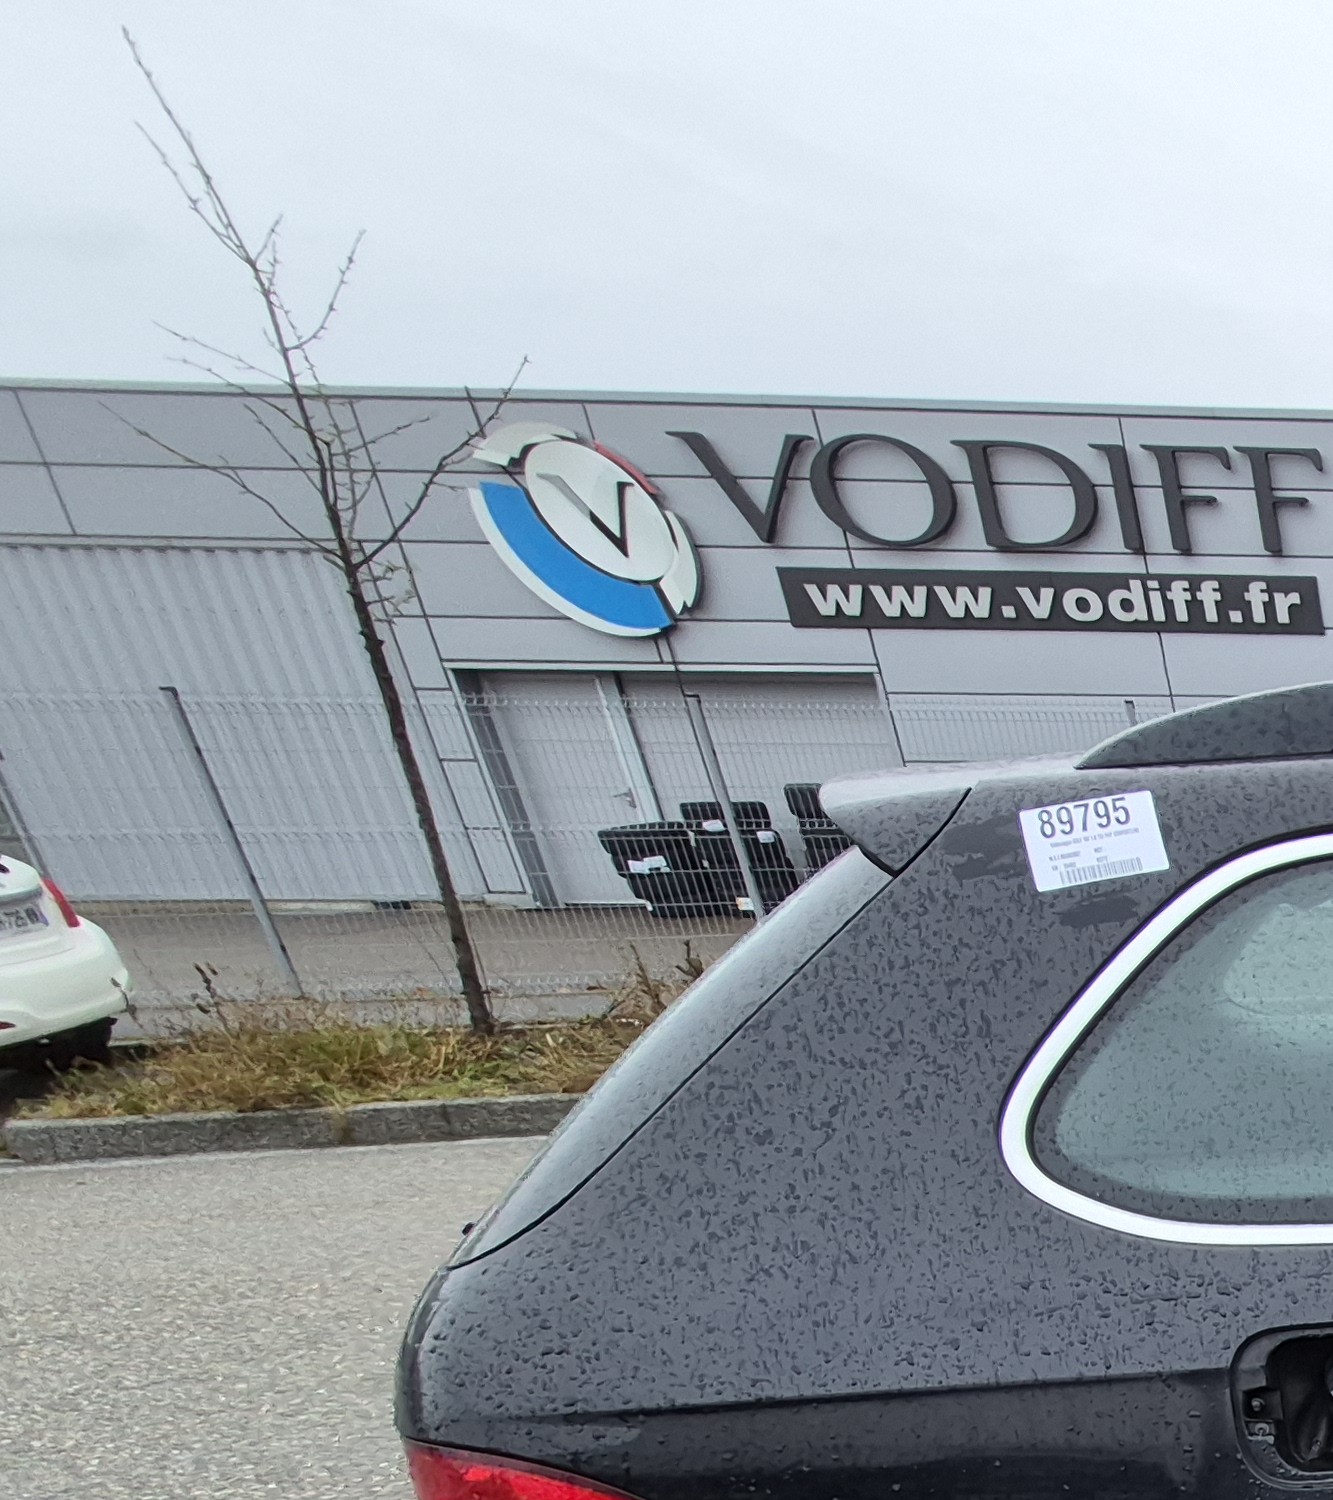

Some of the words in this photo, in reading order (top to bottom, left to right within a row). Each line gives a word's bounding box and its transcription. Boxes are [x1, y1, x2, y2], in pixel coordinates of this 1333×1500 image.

[665, 431, 1323, 555] VODIFF
[803, 579, 1301, 624] www.vodiff.fr
[1037, 797, 1131, 839] 89795
